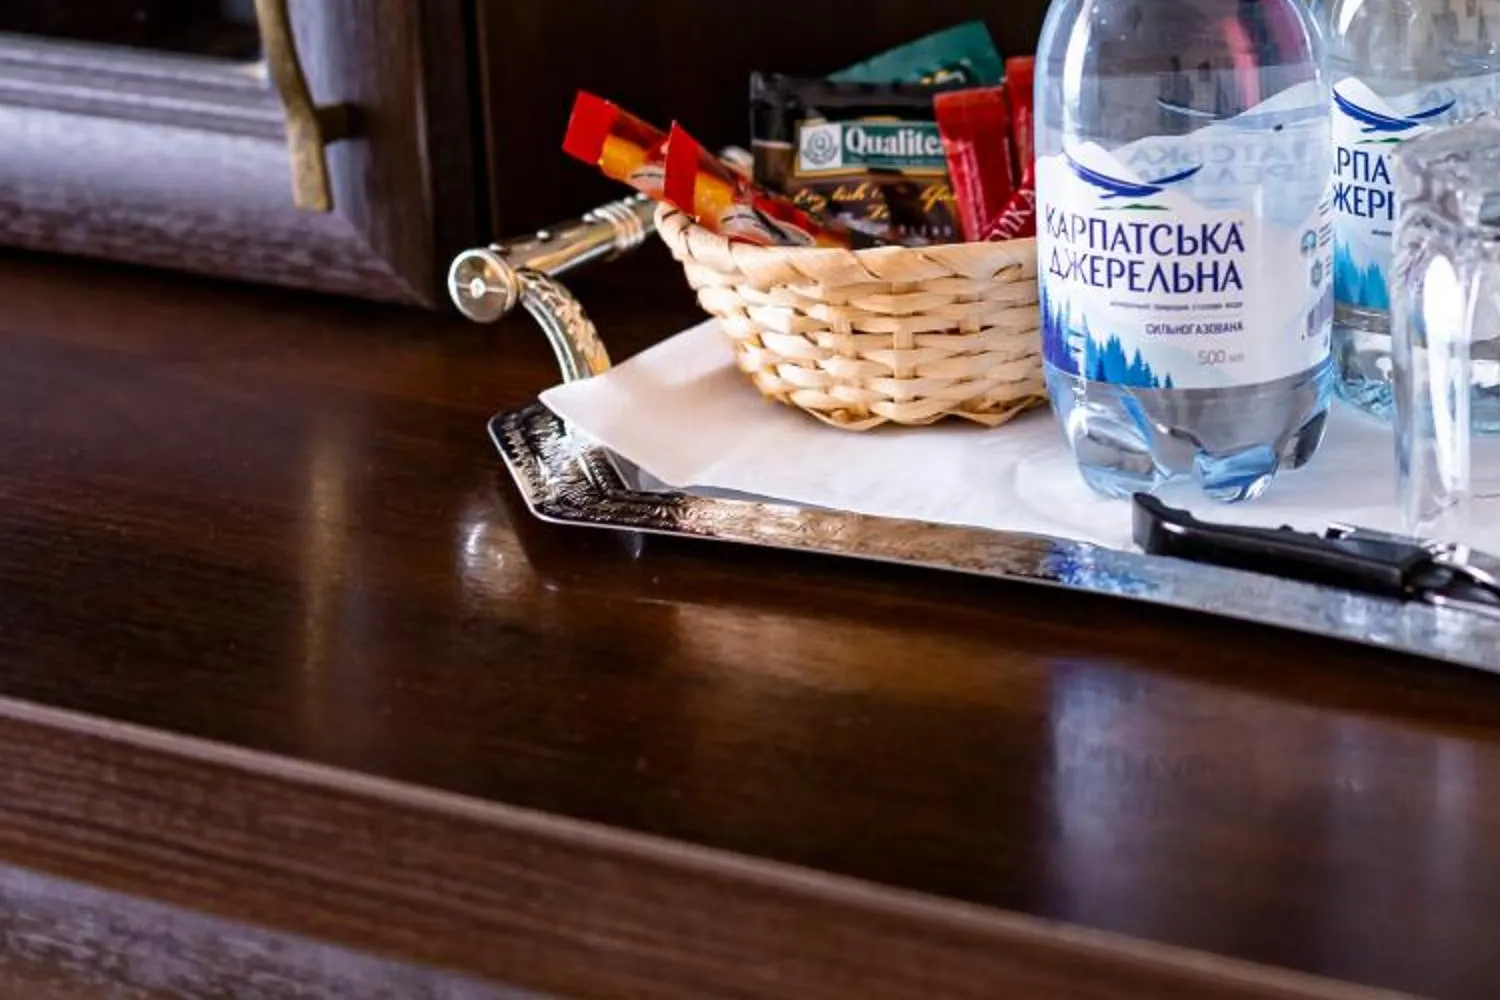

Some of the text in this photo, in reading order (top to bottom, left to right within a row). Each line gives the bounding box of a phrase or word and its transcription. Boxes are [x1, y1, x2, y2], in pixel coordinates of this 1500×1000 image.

[846, 126, 945, 157] Qualite
[1333, 146, 1392, 185] РПА
[1045, 203, 1245, 257] КАРПАТСЬКА
[1049, 245, 1244, 294] ДЖЕРЕЛЬНА
[1145, 320, 1244, 336] СИЛЬНОГАЗОВАНА
[1197, 349, 1226, 366] 500
